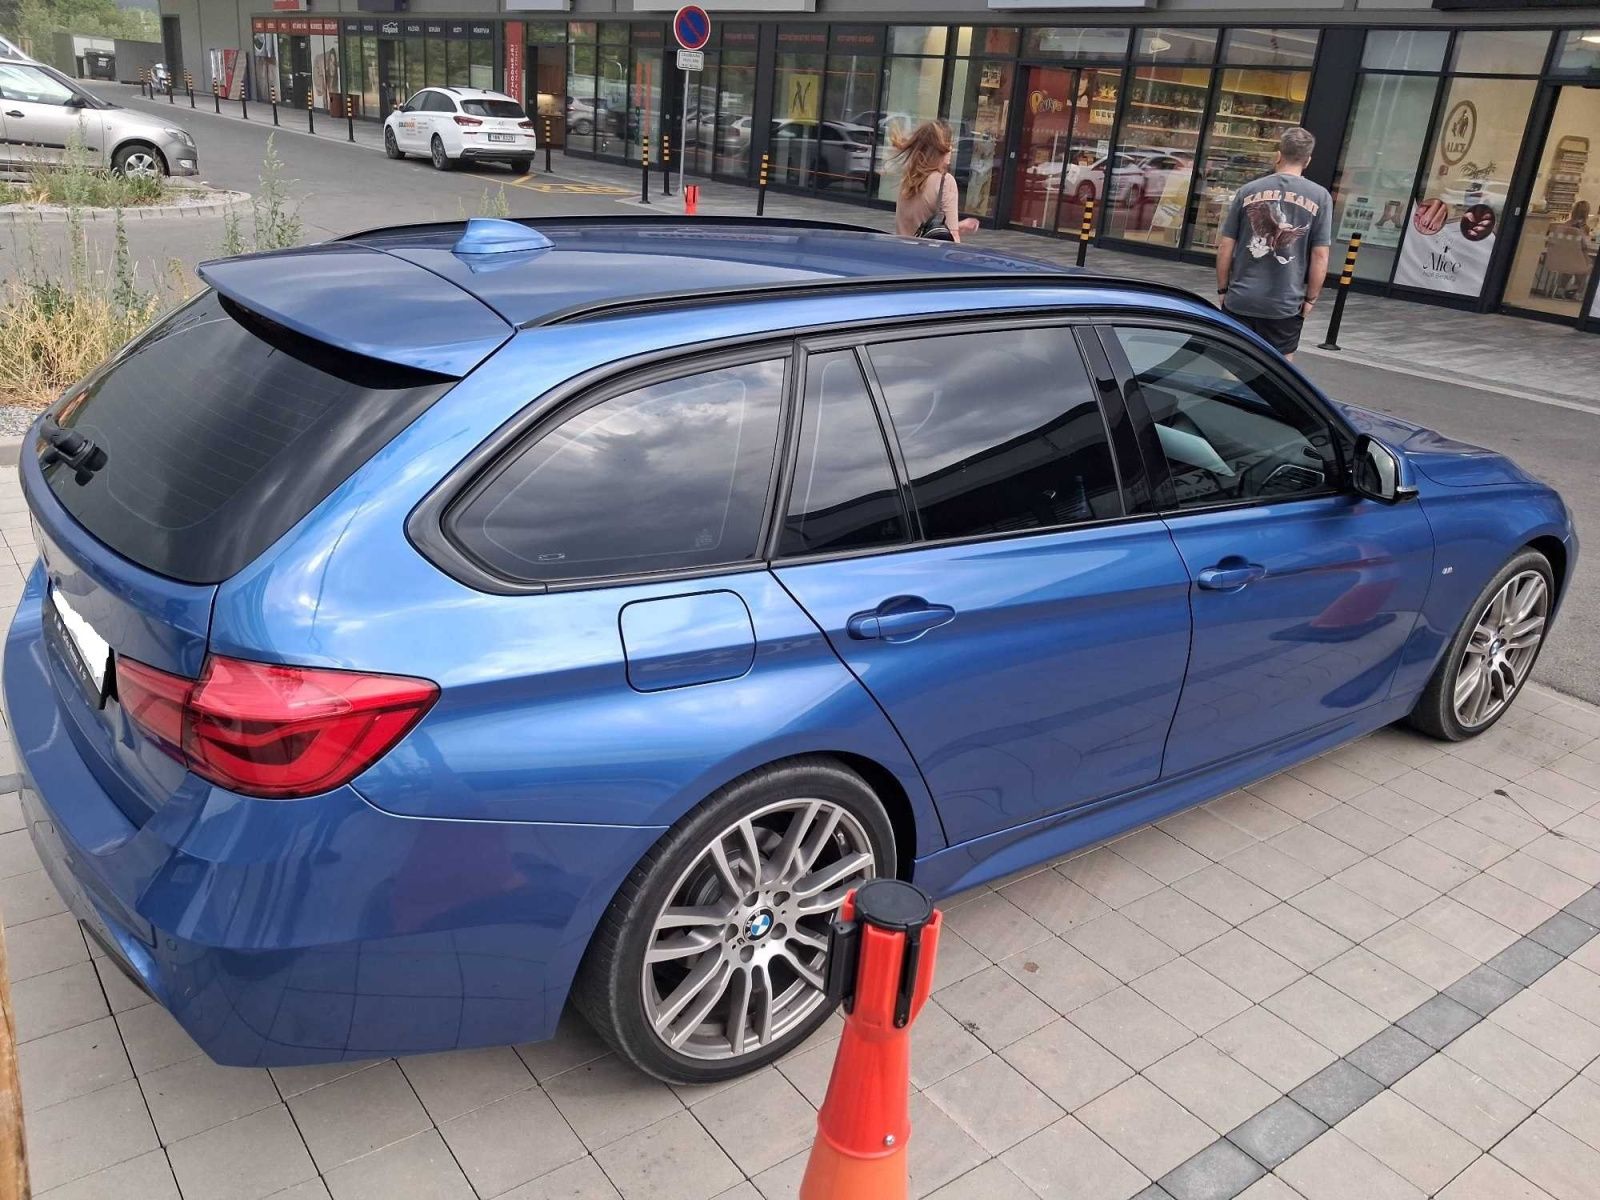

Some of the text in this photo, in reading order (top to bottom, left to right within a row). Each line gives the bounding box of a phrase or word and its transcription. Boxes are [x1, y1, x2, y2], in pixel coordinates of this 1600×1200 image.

[1446, 142, 1466, 153] ALICE
[1243, 189, 1319, 216] KARL KANI
[1422, 252, 1461, 273] Alice
